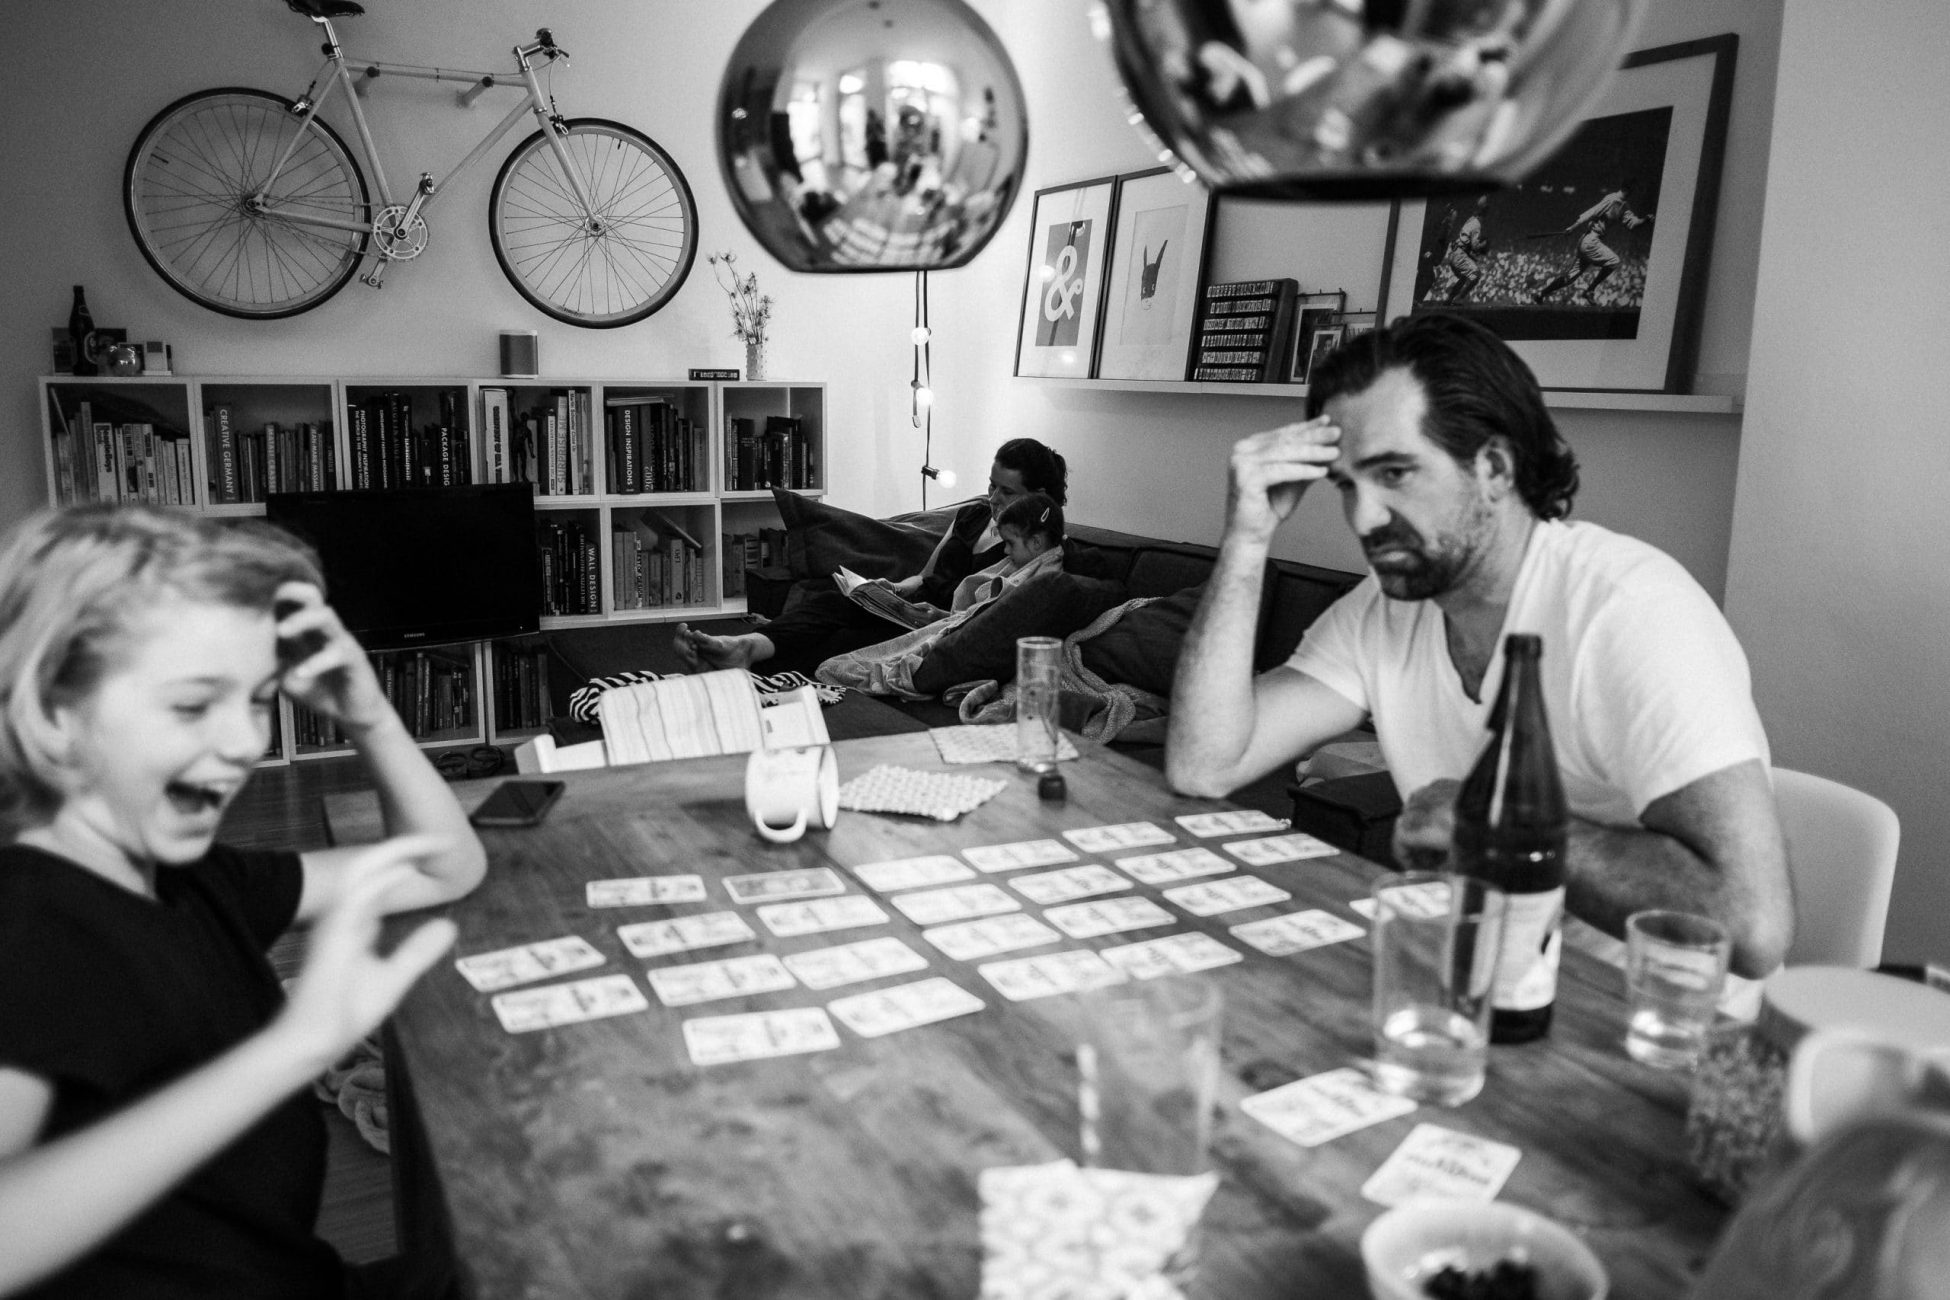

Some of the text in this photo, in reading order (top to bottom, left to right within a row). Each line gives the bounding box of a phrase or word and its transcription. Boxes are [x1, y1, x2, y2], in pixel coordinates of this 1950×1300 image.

[220, 409, 233, 494] CREATIVE GERMANY
[360, 410, 368, 452] PHOTOGRAPHY
[441, 427, 449, 462] PACKAGE
[558, 416, 567, 483] SURPRISE ME
[624, 410, 633, 485] DESIGN INSPIRATIONS
[644, 466, 653, 490] 2002
[589, 575, 597, 608] DESIGN
